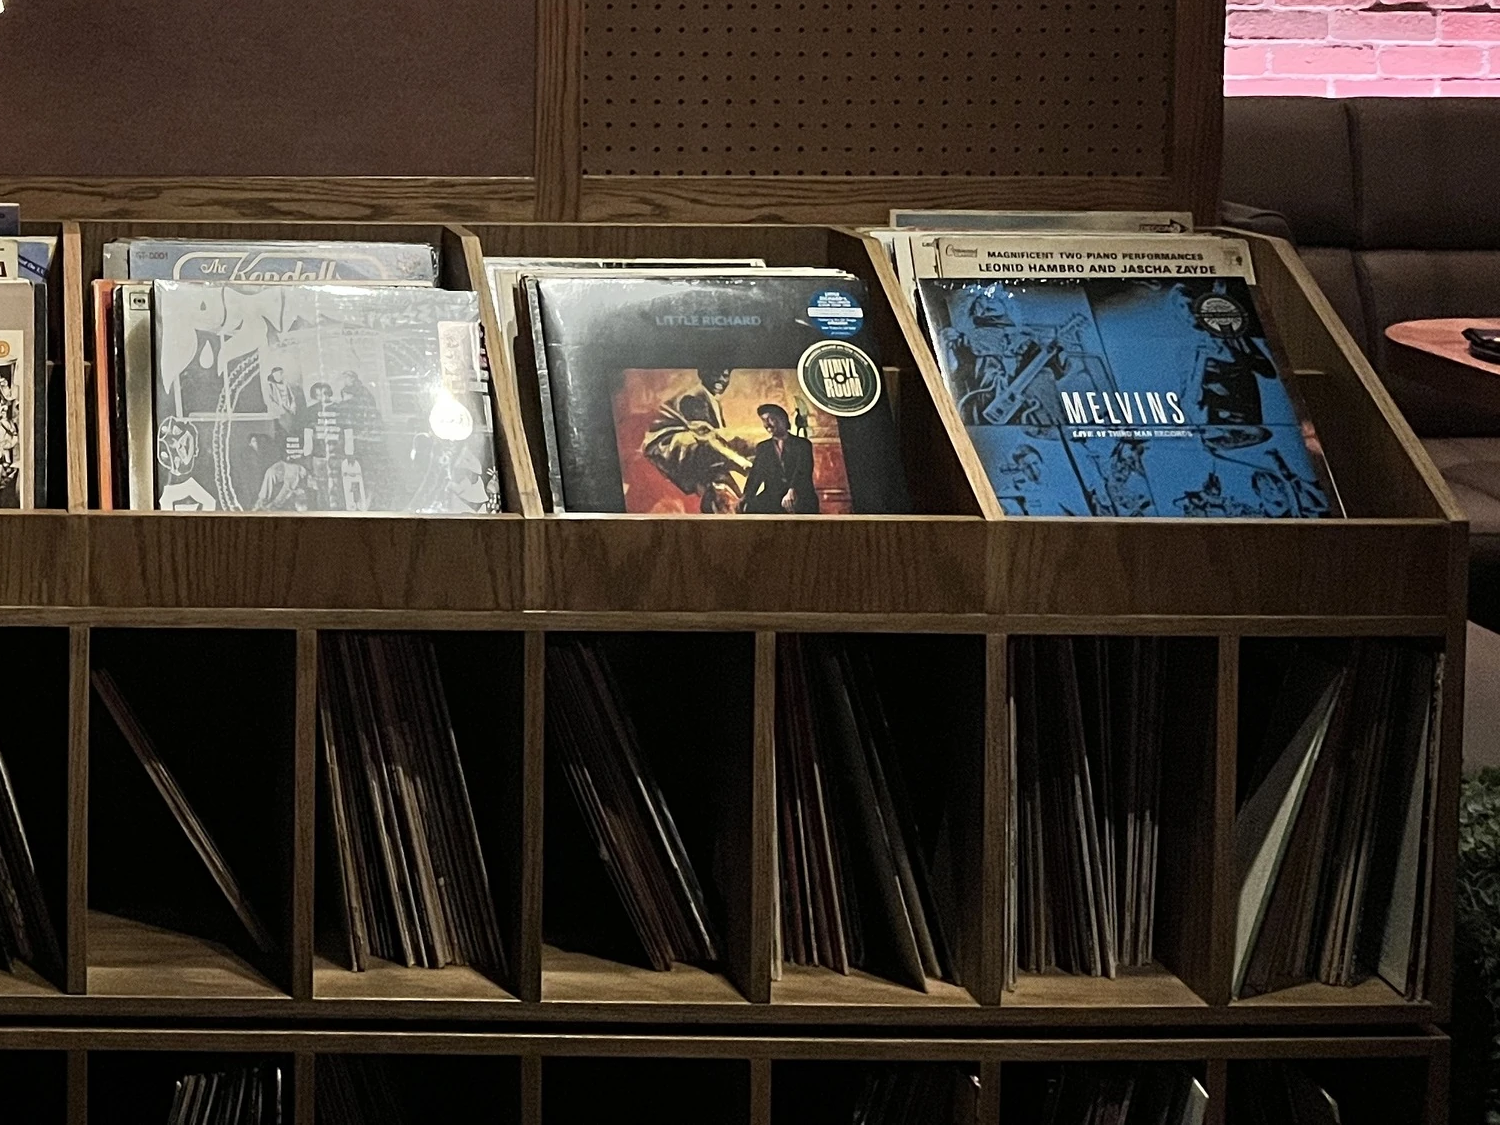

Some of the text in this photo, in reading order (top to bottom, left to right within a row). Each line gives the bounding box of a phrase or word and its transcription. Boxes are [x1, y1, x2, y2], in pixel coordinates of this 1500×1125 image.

[987, 251, 1054, 260] MAGNIFICENT
[1122, 252, 1204, 261] PERFORMANCES
[978, 263, 1217, 274] LEONID HAMBRO AND JASCHA ZAYDE
[656, 316, 762, 326] LITTLE RICHARD
[818, 358, 859, 378] VINYL
[823, 377, 864, 398] ROOM
[1061, 391, 1185, 424] MELVINS
